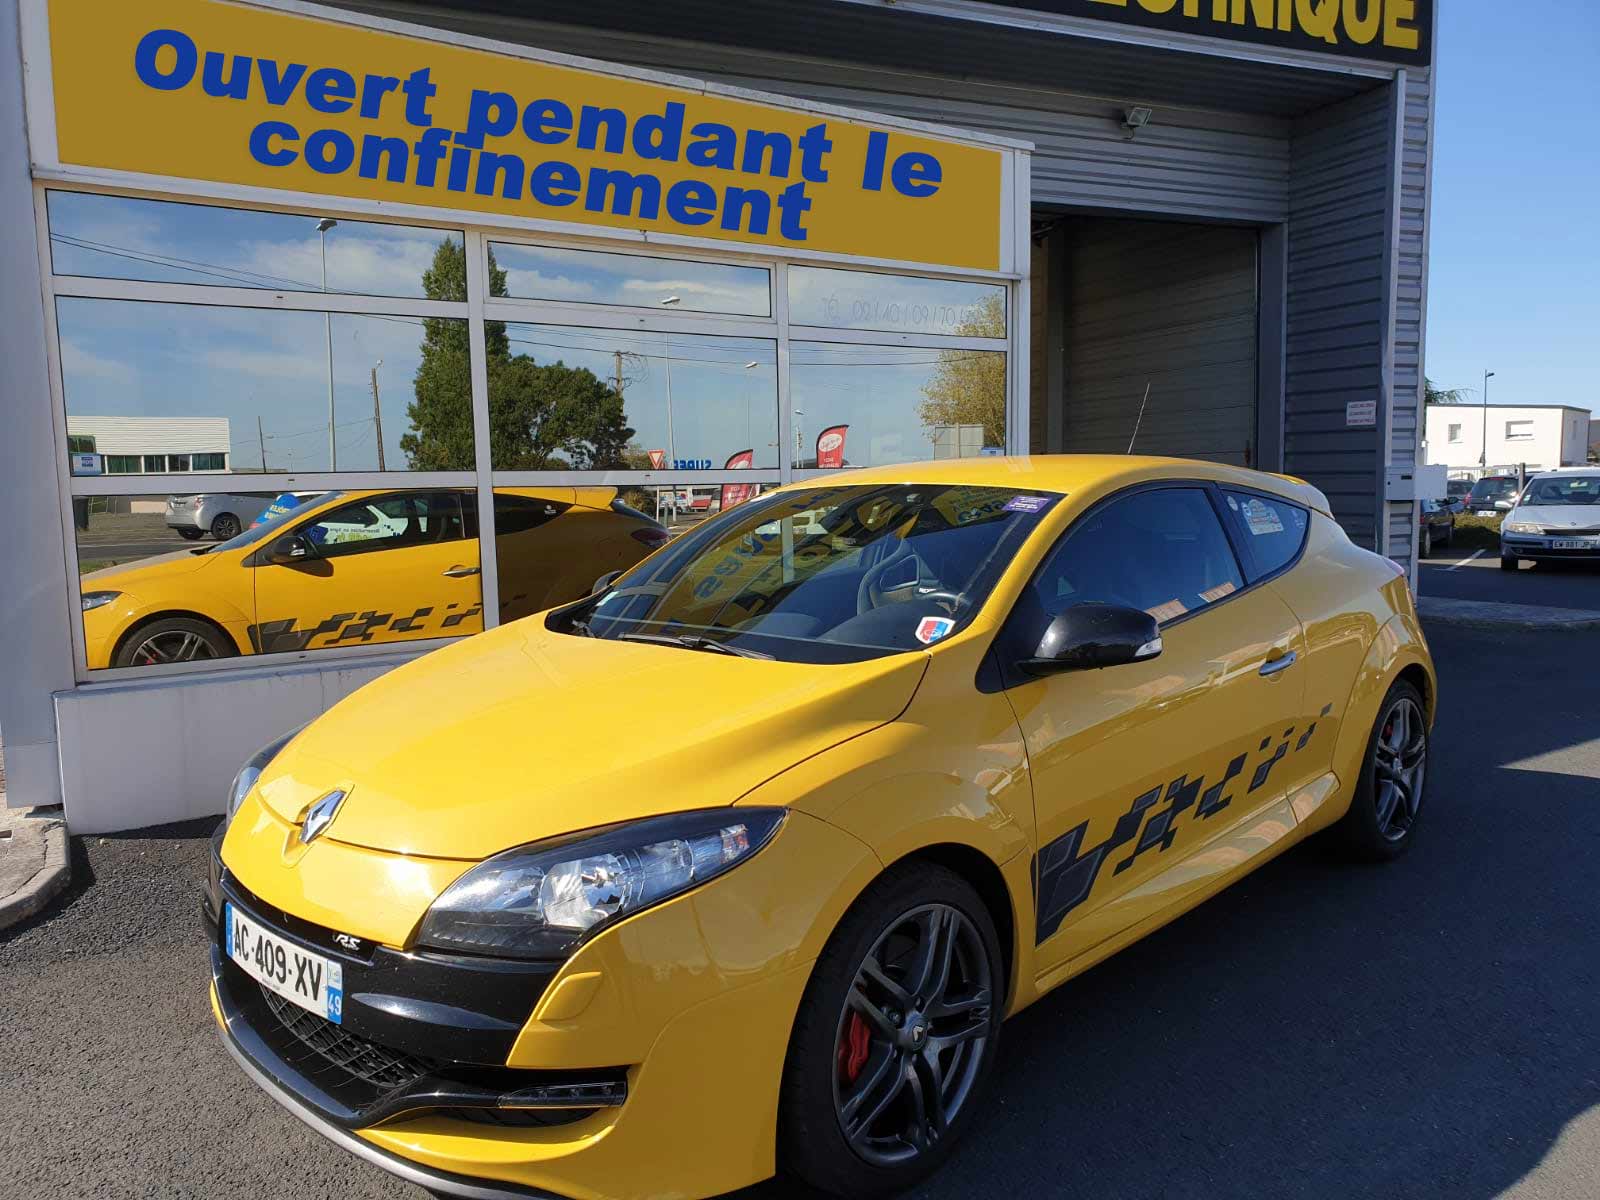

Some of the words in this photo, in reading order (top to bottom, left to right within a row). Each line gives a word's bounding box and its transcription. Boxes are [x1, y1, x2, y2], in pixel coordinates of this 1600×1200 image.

[134, 28, 438, 127] Ouvert
[464, 89, 834, 184] pendant
[863, 130, 942, 197] le
[250, 121, 812, 240] confinement
[327, 994, 342, 1017] 49
